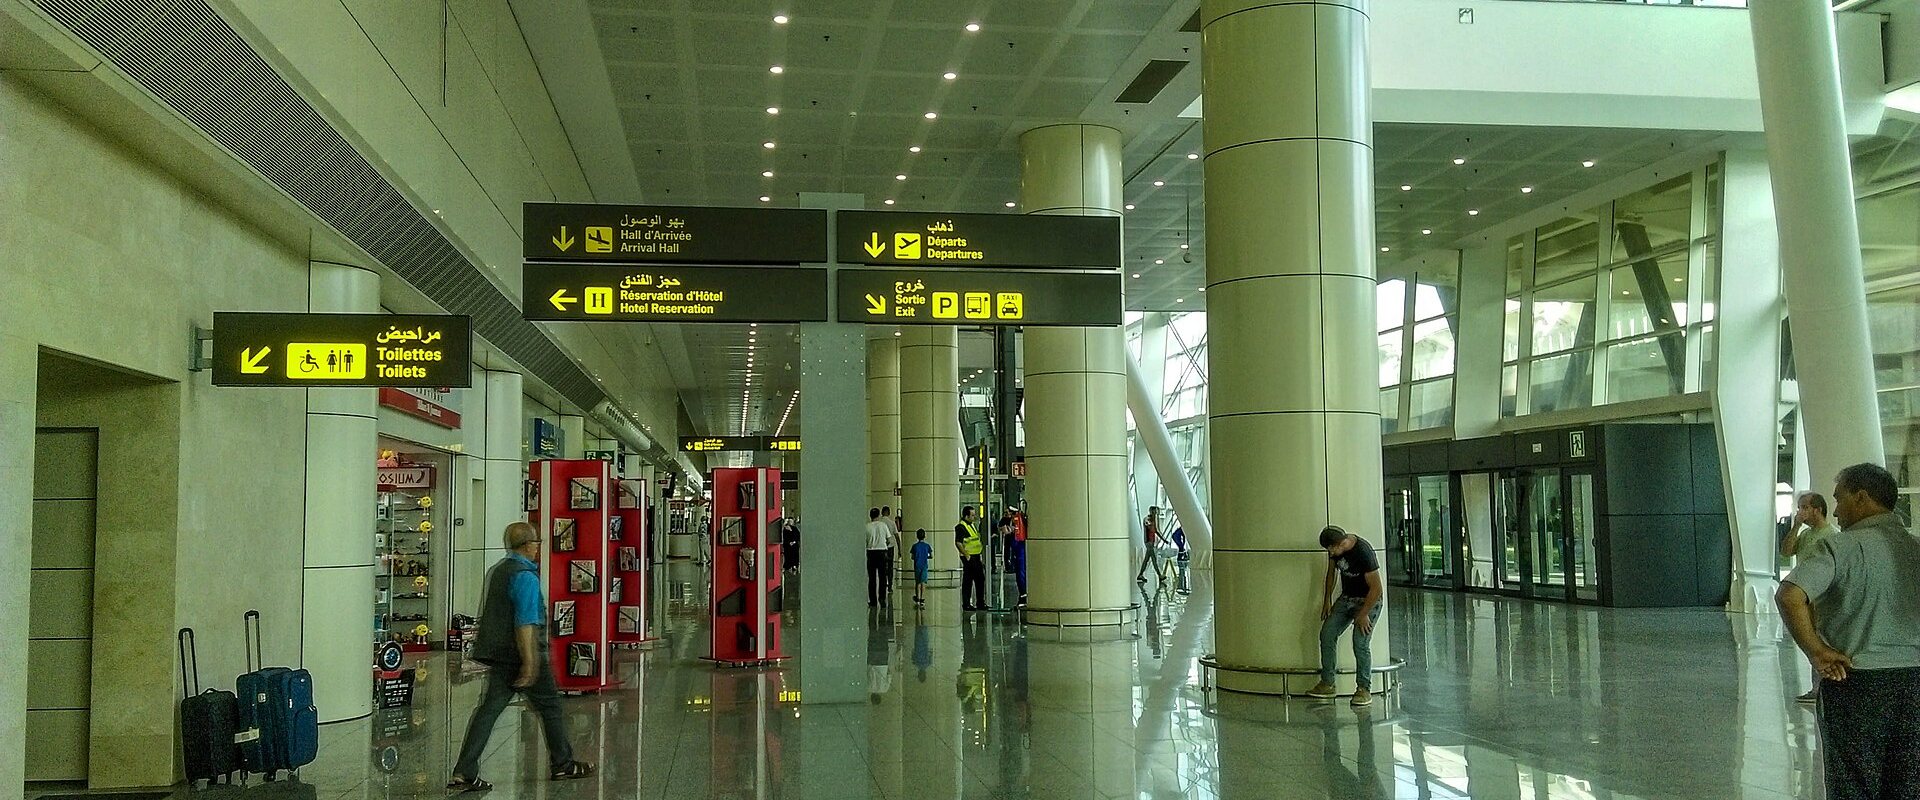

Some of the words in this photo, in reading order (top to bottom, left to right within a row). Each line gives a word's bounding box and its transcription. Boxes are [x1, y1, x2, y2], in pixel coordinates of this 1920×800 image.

[620, 213, 662, 228] الوصول
[665, 217, 685, 229] بهو
[927, 219, 954, 235] ذهاب
[620, 229, 641, 241] Hall
[644, 230, 692, 241] d'Arrivée
[927, 235, 967, 249] Départs
[620, 242, 656, 253] Arrival
[659, 242, 680, 254] Hall
[927, 248, 984, 260] Departures
[619, 273, 653, 289] الفندق
[656, 275, 681, 289] حجز
[895, 279, 925, 294] خروج
[592, 294, 605, 308] H
[620, 289, 684, 302] Réservation
[685, 290, 723, 302] d'Hôtel
[895, 293, 926, 305] Sortie
[620, 302, 649, 314] Hotel
[651, 303, 714, 315] Reservation
[895, 305, 916, 317] Exit
[939, 297, 952, 314] P
[376, 326, 442, 344] مراحيض
[376, 346, 442, 362] Toilettes
[376, 363, 427, 378] Toilets
